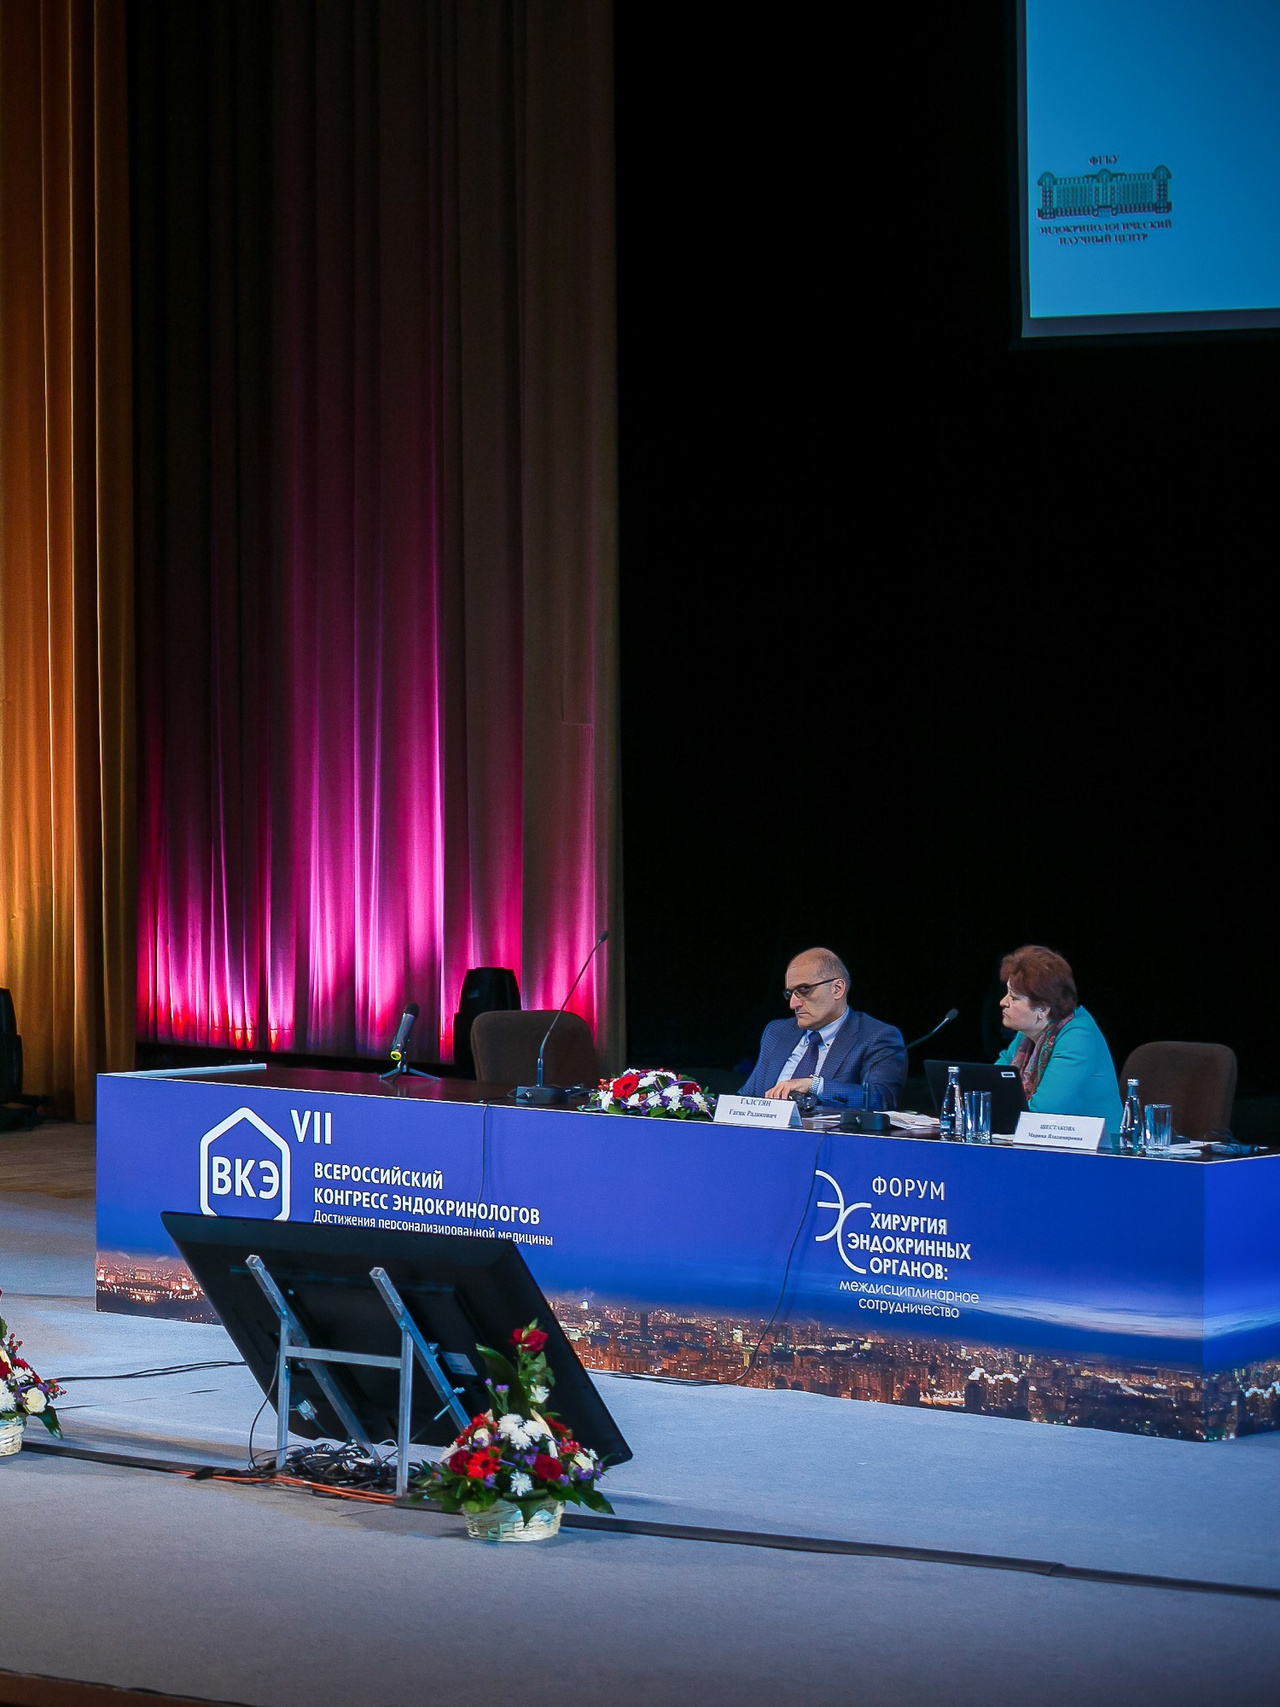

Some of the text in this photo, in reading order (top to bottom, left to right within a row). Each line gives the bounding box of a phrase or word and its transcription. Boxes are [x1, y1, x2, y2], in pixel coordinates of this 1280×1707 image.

[290, 1109, 332, 1145] VII
[210, 1154, 281, 1200] ВКЭ
[313, 1161, 444, 1190] ВСЕРОССИЙСКИЙ
[872, 1175, 946, 1201] ФОРУМ
[313, 1187, 541, 1226] КОНГРЕСС ЭНДОКРИНОЛОГОВ
[312, 1209, 376, 1228] Достижения
[497, 1230, 554, 1247] медицины
[870, 1212, 948, 1236] ХИРУРГИЯ
[847, 1232, 972, 1261] ЭНДОКРИННЫХ
[869, 1256, 949, 1281] ОРГАНОВ:
[839, 1280, 980, 1304] междисциплинарное
[858, 1298, 960, 1319] сотрудничество
